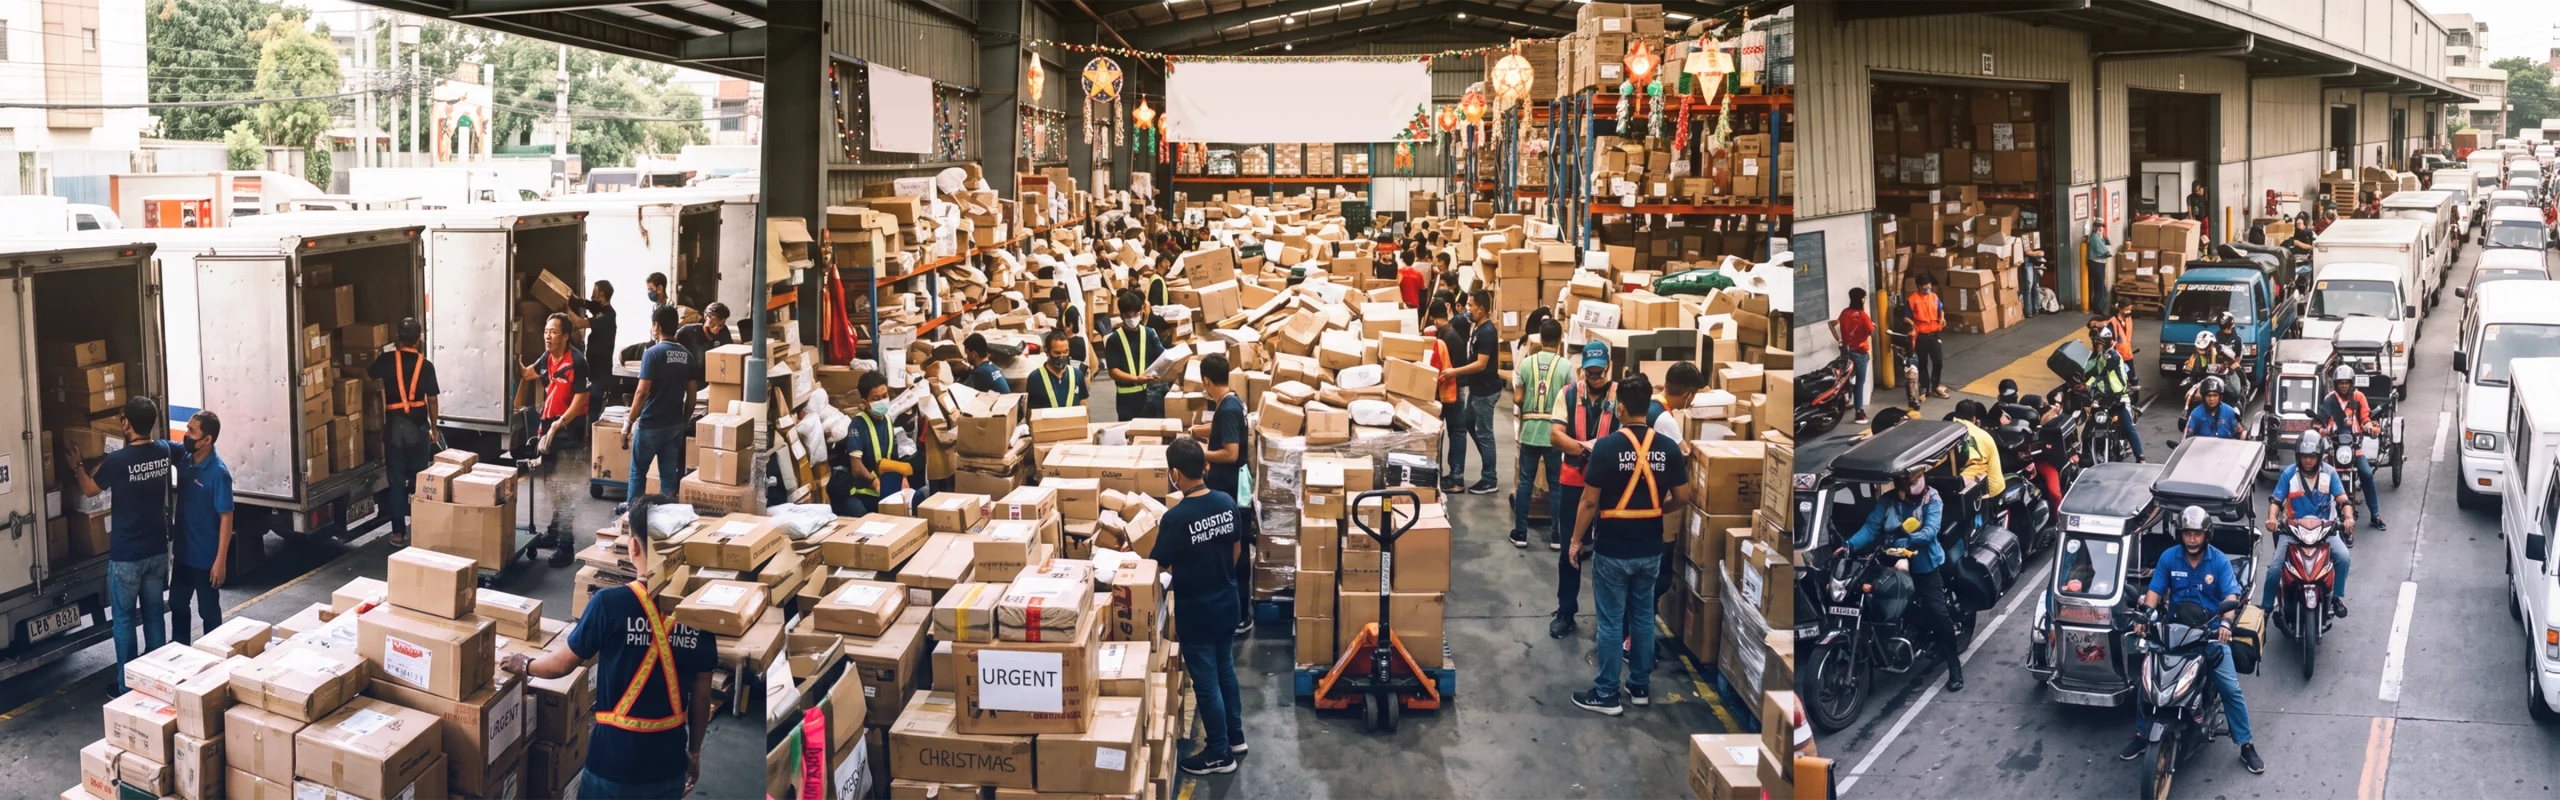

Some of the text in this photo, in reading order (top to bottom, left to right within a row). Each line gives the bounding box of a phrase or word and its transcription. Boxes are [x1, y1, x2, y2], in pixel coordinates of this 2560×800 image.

[127, 457, 170, 474] LOGISTICS
[1618, 451, 1667, 462] LOGTICS
[1188, 509, 1234, 535] LOGISTICS
[626, 633, 698, 649] PHILINES
[981, 667, 1058, 688] URGENT
[489, 702, 520, 741] URGENT
[919, 747, 1016, 773] CHRISTMAS
